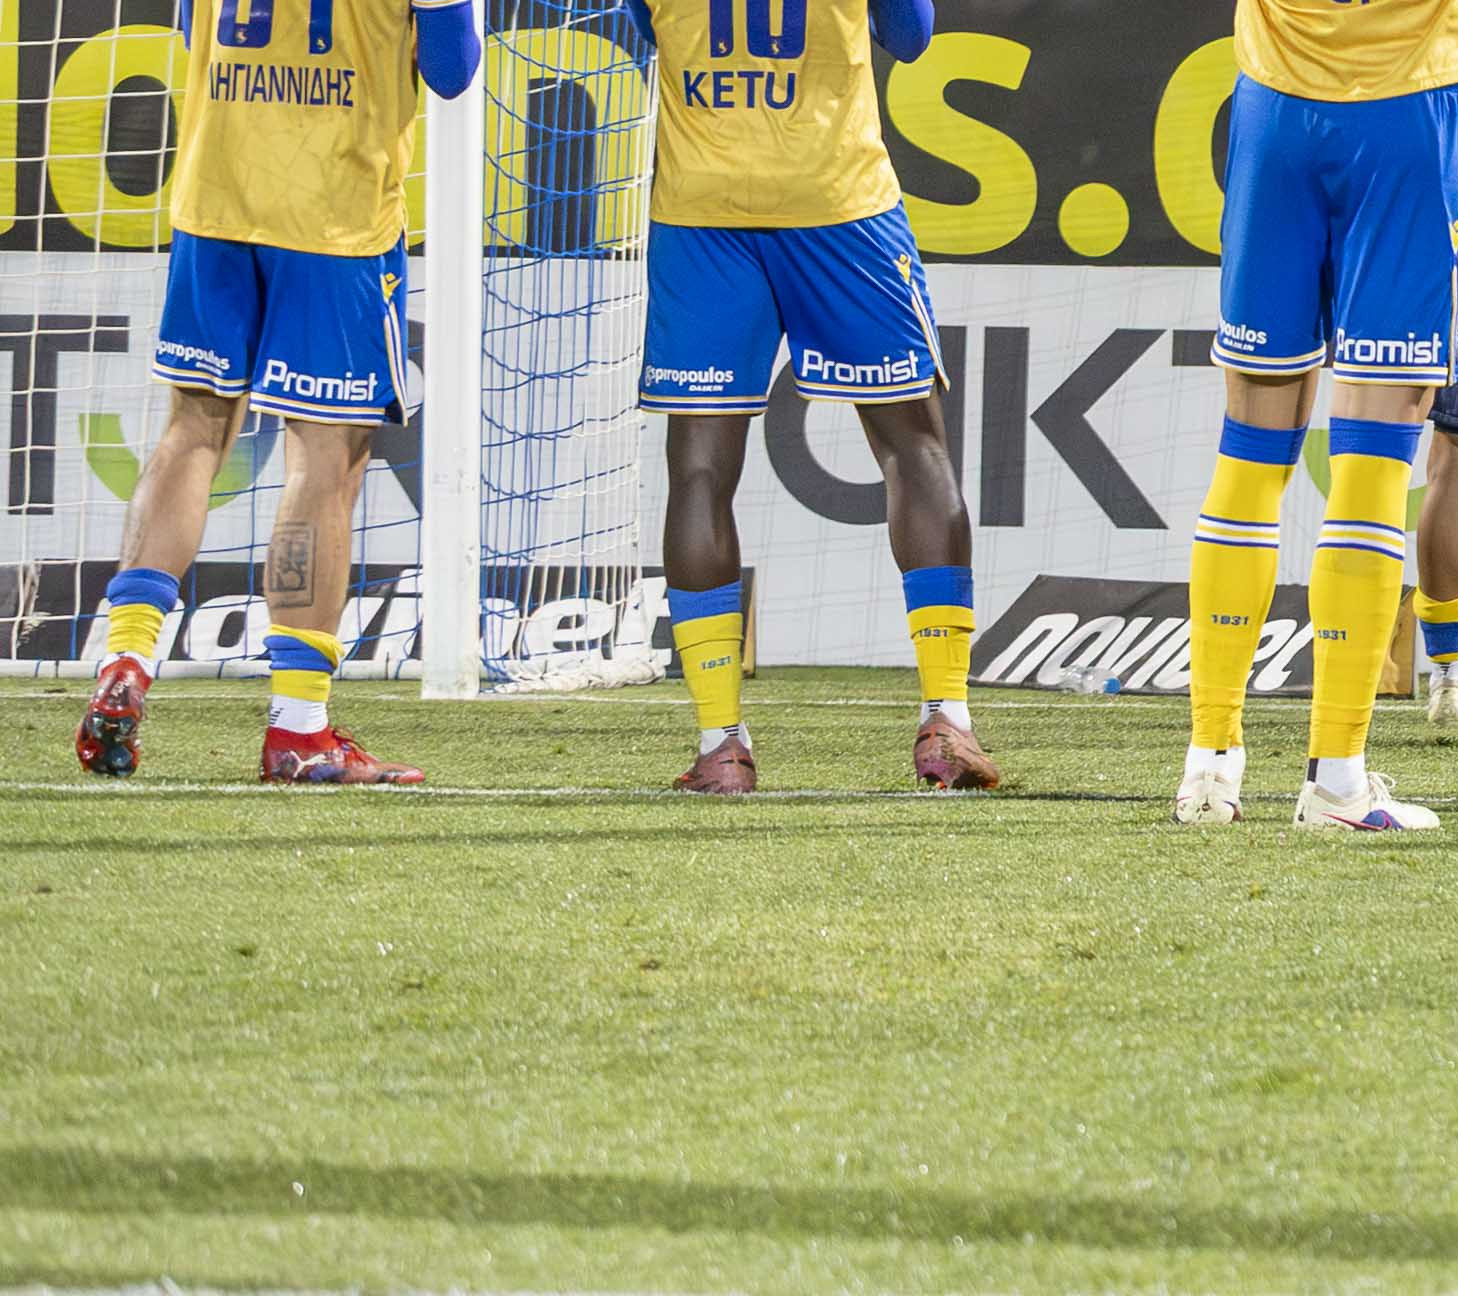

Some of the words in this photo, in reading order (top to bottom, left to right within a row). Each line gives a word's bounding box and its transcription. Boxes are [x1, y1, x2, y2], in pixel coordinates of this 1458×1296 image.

[684, 69, 796, 110] KETU
[1336, 328, 1443, 363] Promist
[262, 358, 378, 402] Promist
[802, 349, 919, 384] Promist
[1211, 614, 1249, 625] 1931
[1317, 629, 1347, 641] 1931
